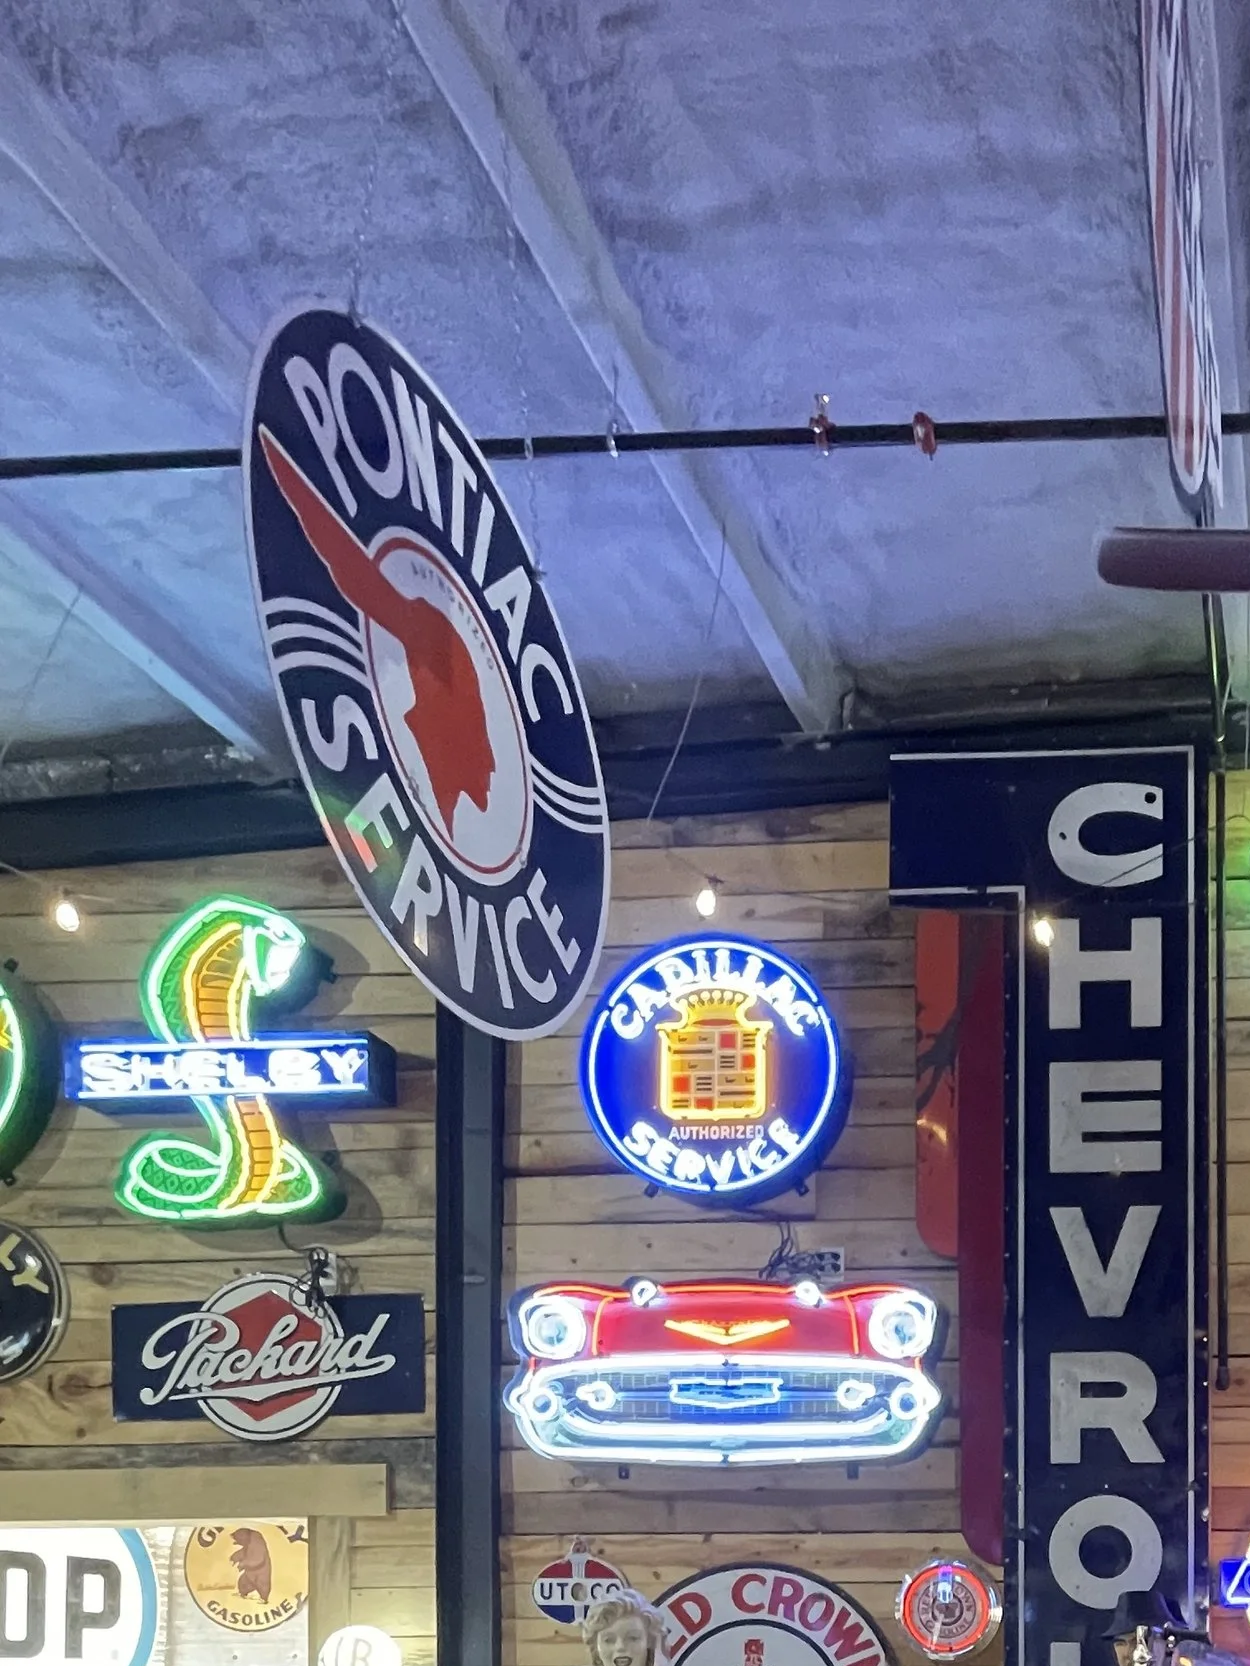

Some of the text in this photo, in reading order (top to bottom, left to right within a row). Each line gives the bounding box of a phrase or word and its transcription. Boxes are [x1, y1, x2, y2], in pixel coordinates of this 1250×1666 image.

[283, 342, 574, 722] PONTIAC
[301, 697, 580, 1010] SERVICE
[610, 948, 821, 1040] CADILLAC
[82, 1048, 367, 1094] SHELBY
[624, 1118, 802, 1183] SERVICE
[668, 1124, 765, 1141] AUTHORIZED
[140, 1313, 396, 1406] Packard
[207, 1598, 293, 1626] GASOLINE
